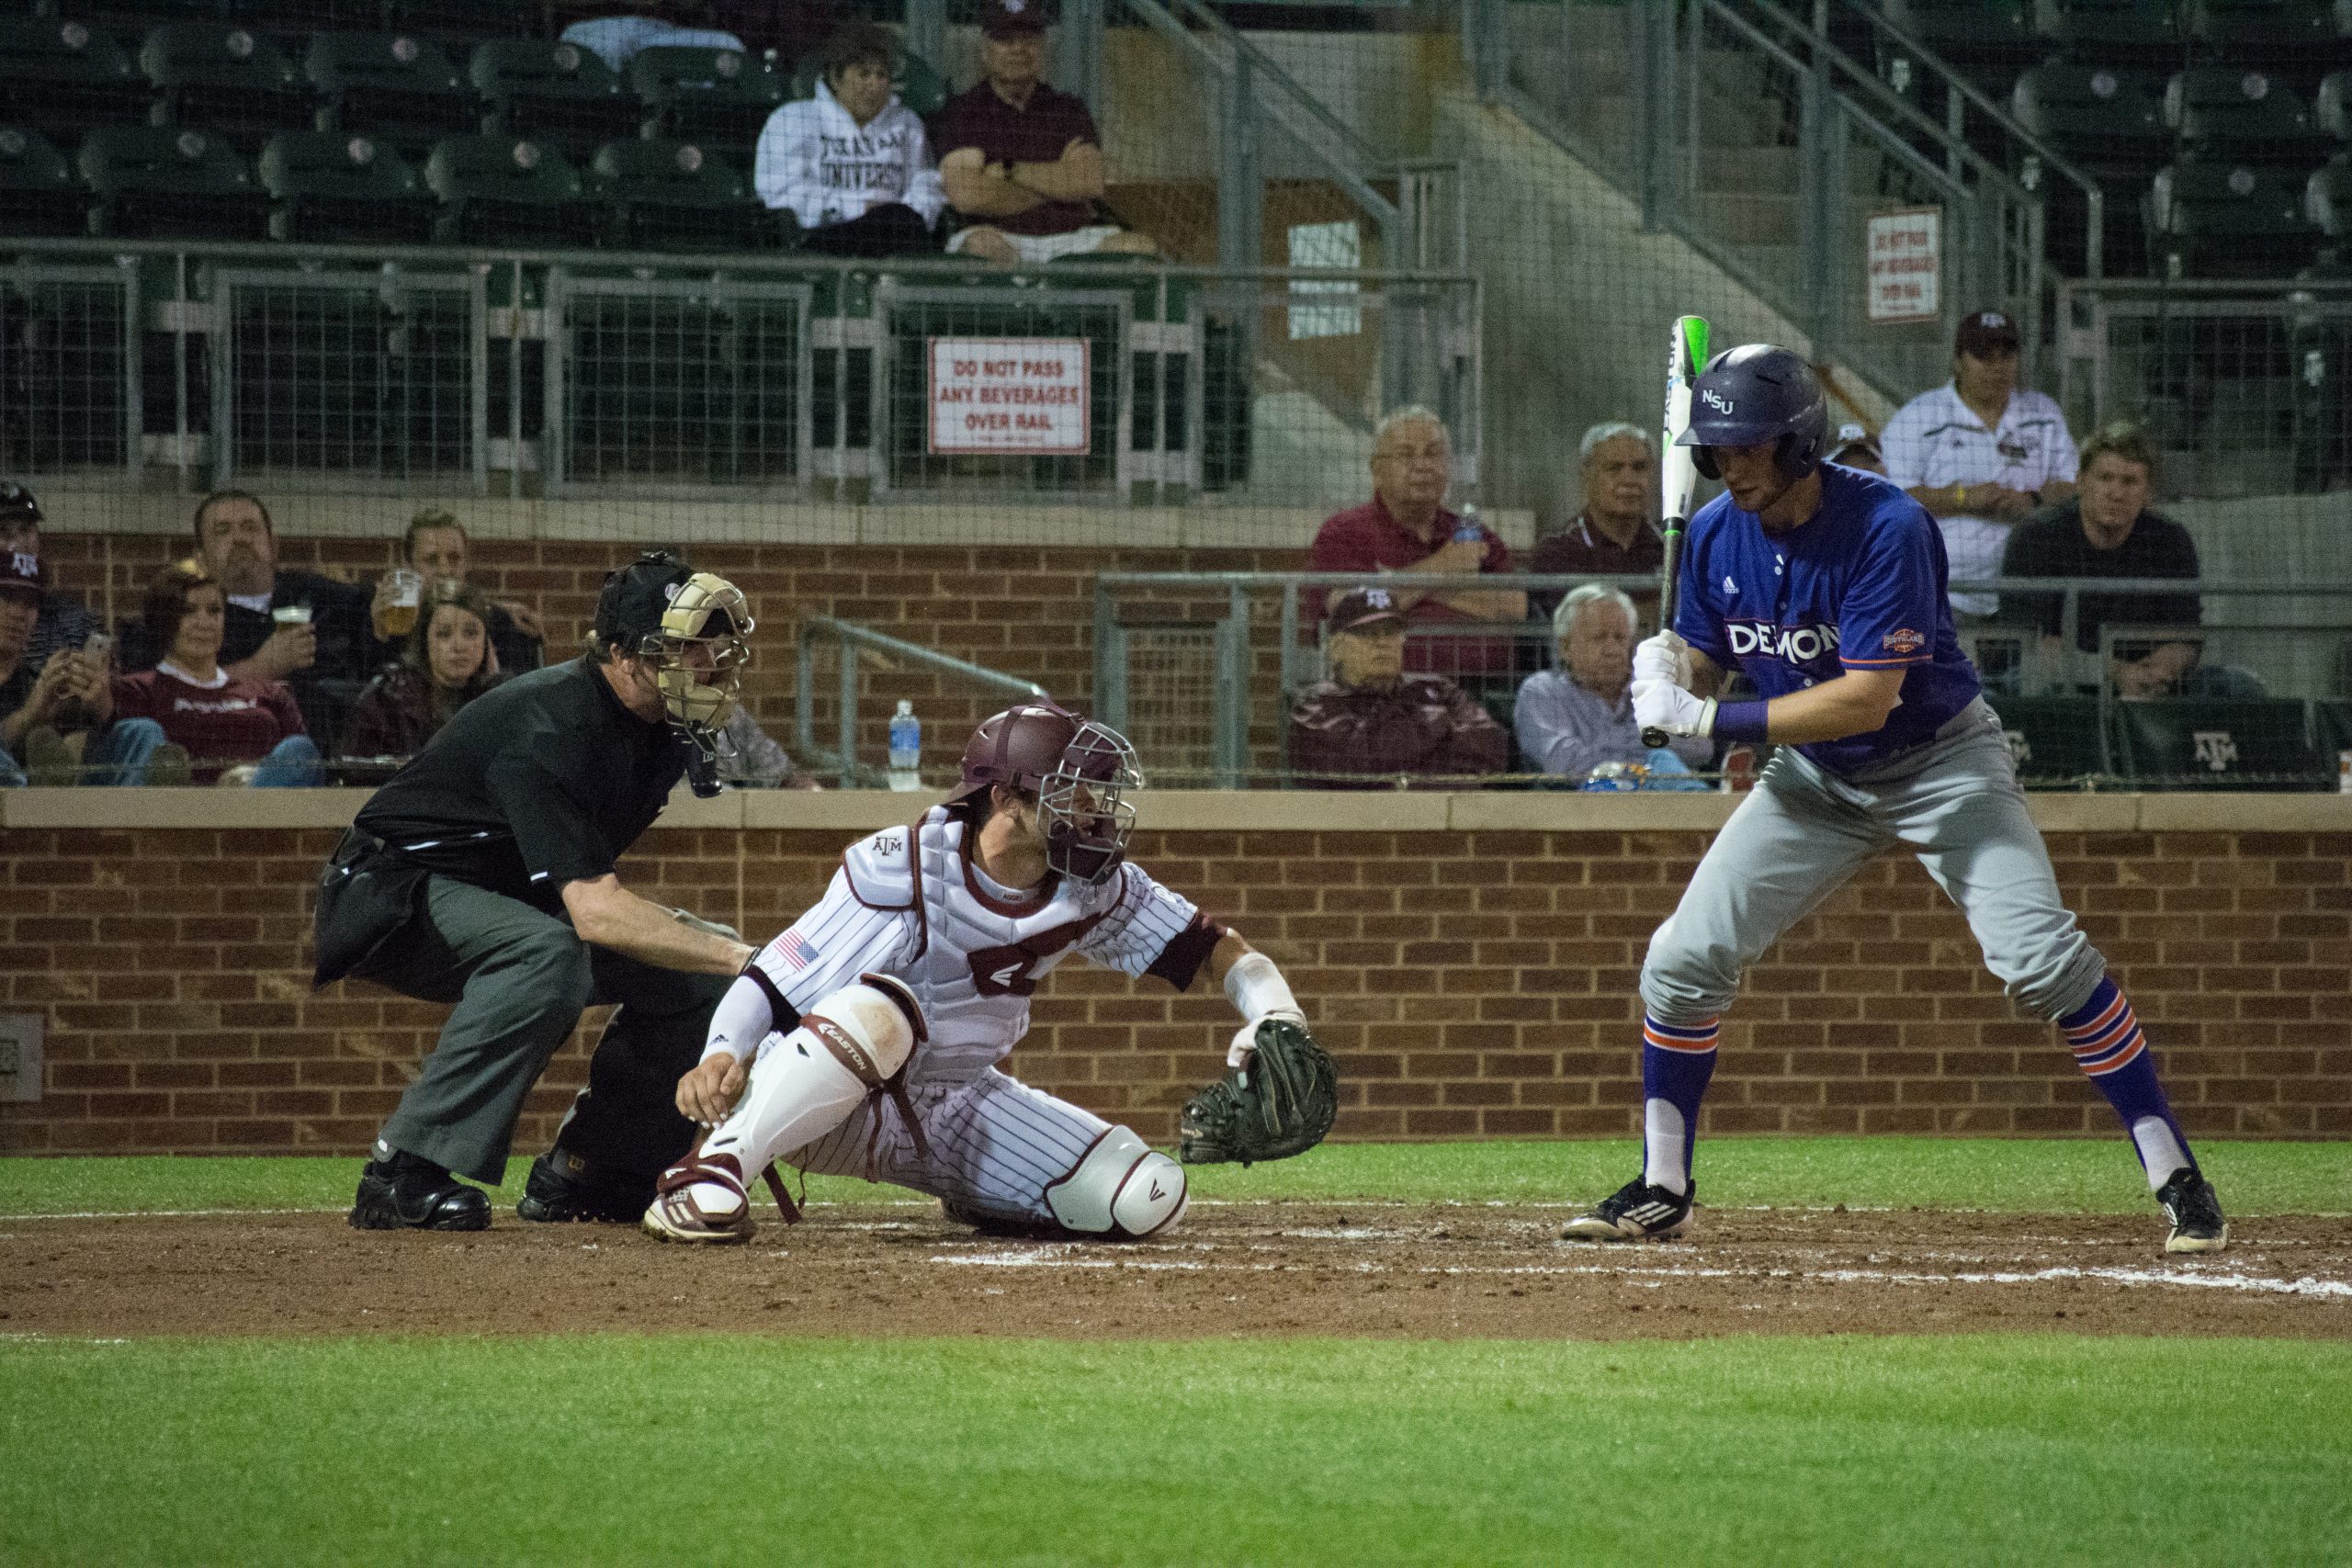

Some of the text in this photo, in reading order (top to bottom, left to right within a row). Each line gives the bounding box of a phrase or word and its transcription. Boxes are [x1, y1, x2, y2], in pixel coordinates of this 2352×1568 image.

[953, 359, 1063, 378] DO NOT PASS
[940, 385, 1079, 404] ANY BEVERAGES
[1702, 389, 1734, 415] NSU
[966, 413, 1053, 431] OVER RAIL
[826, 1029, 867, 1071] EASTON
